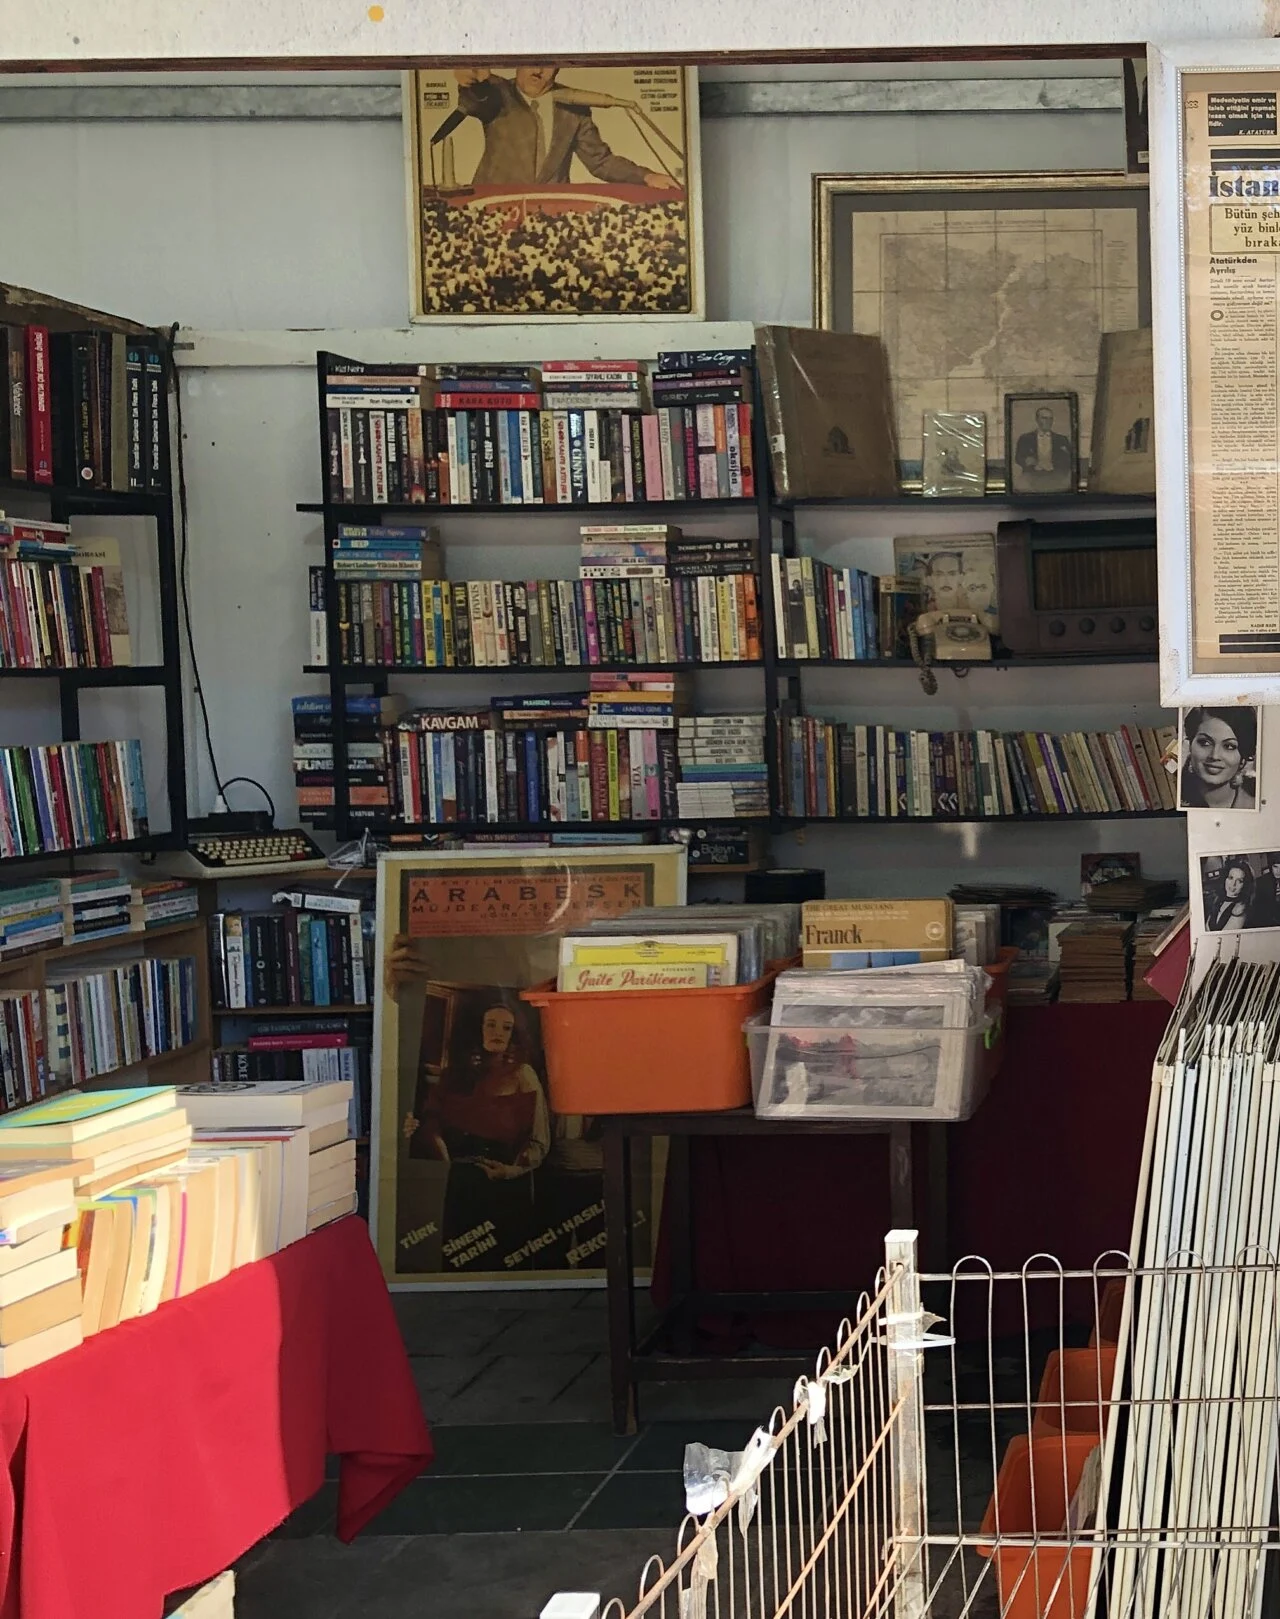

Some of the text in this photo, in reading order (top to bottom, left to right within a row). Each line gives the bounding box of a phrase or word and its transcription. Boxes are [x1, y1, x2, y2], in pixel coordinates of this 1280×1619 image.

[1225, 208, 1257, 219] Bütün
[1234, 222, 1253, 235] yüz
[1209, 257, 1258, 265] Atatürkden
[661, 393, 689, 401] GREY
[572, 448, 585, 489] CİNNET
[728, 446, 740, 485] oksijen
[421, 716, 479, 731] KAVGAM
[412, 884, 642, 904] ARABESK
[806, 903, 820, 911] THE
[822, 903, 849, 911] GREAT
[805, 923, 863, 945] Franck
[619, 968, 697, 988] Parisienne
[399, 1222, 438, 1250] TÜRK
[442, 1220, 496, 1257] SİNEMA
[449, 1235, 498, 1269] TARİHİ
[565, 1232, 608, 1265] REKO
